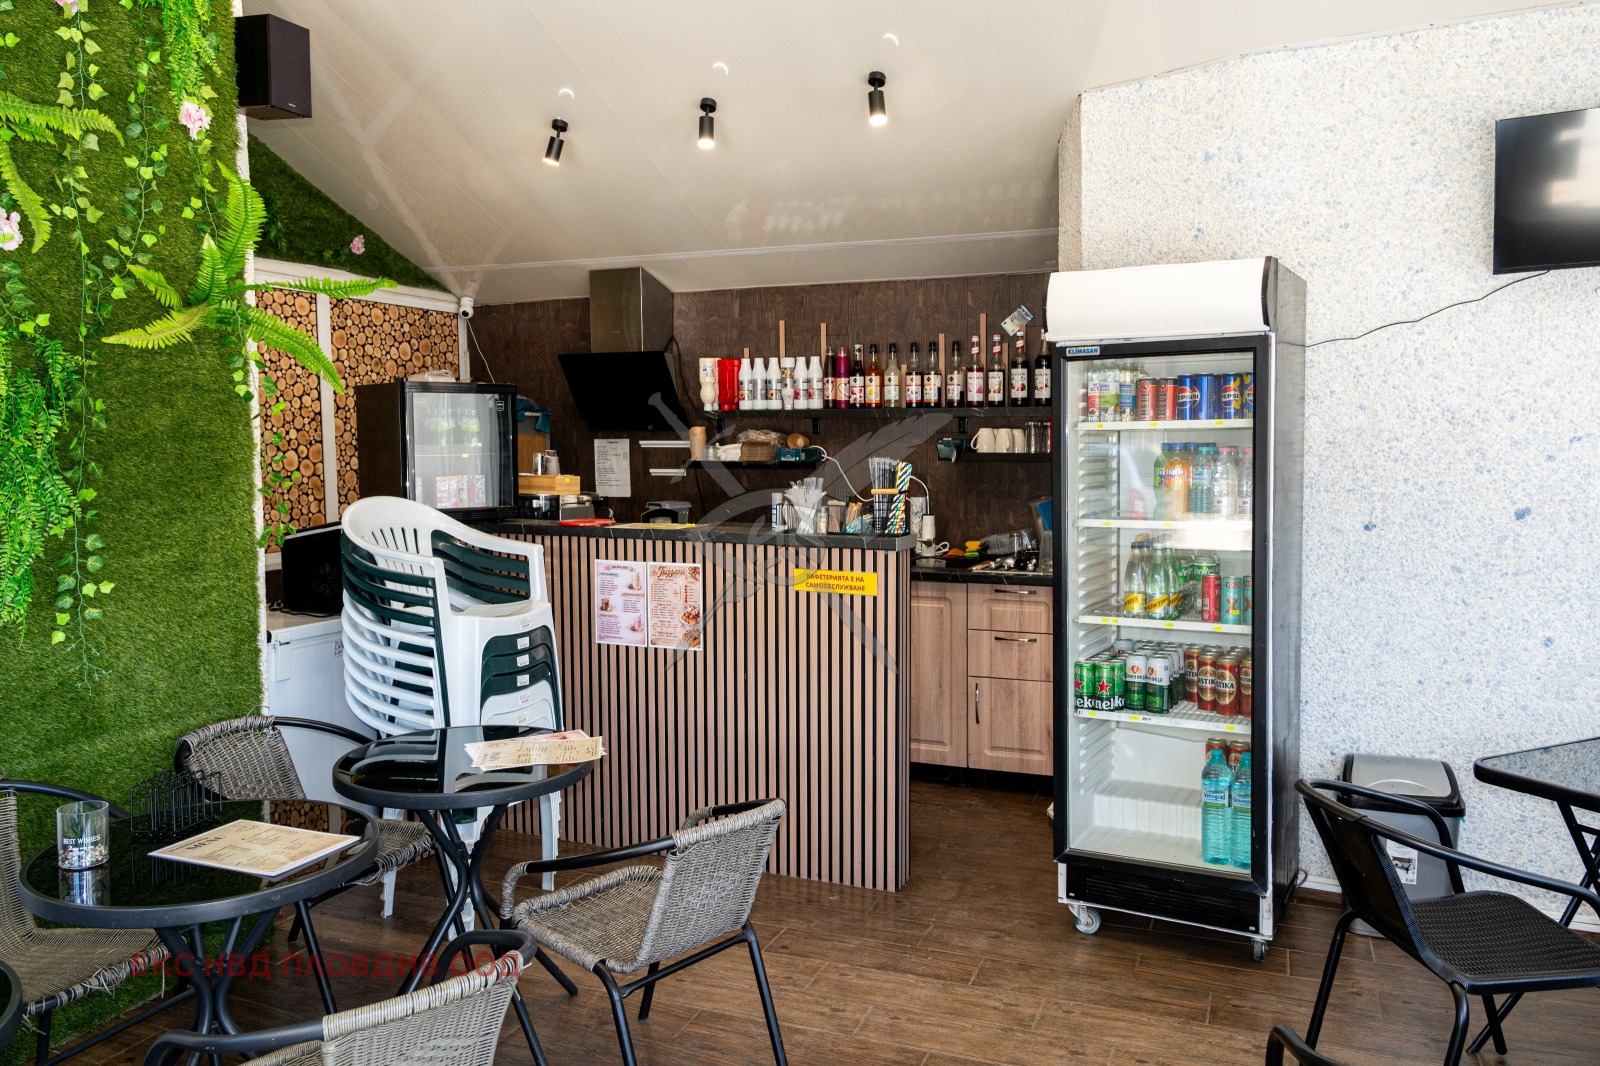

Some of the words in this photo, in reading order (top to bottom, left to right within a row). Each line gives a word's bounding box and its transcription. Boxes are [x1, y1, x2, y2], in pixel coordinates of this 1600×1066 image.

[807, 573, 849, 582] КАФЕТЕРИЯТА
[805, 582, 865, 592] САМООБСЛУЖВАНЕ
[1216, 681, 1235, 690] STIKA
